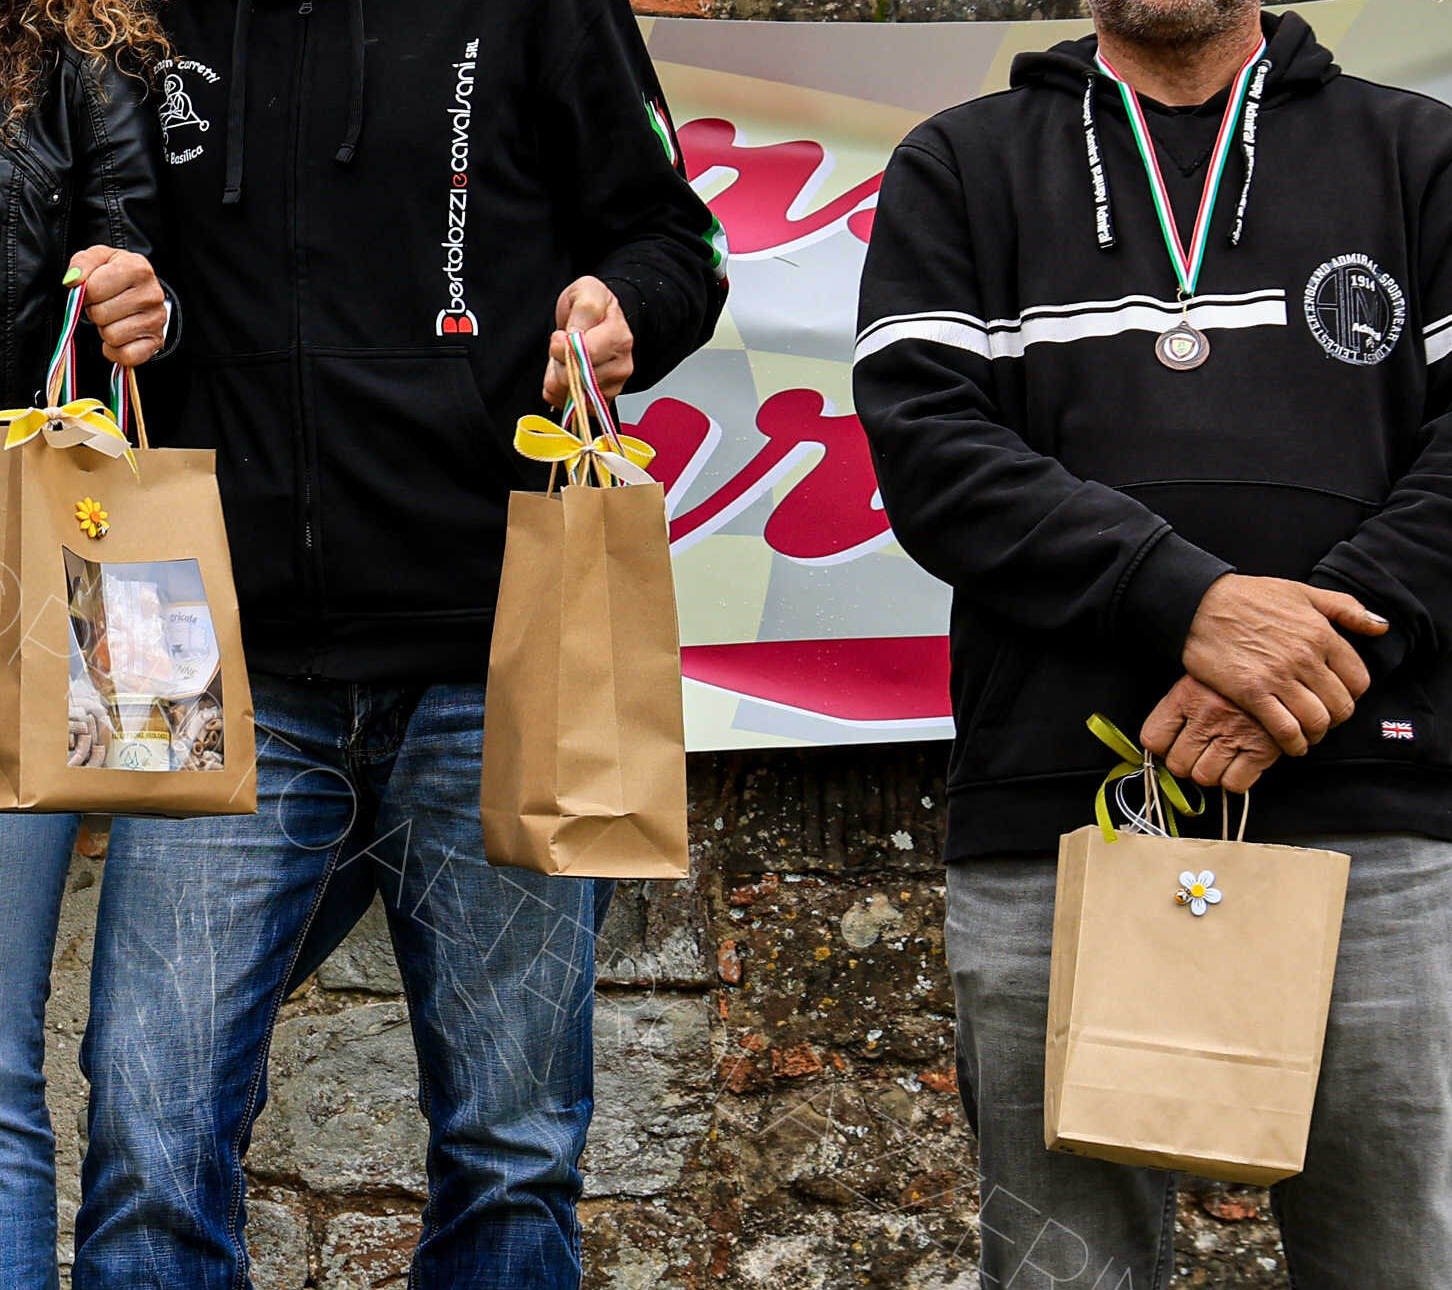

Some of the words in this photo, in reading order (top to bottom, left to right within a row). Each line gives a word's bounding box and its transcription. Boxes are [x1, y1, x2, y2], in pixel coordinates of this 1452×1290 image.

[465, 38, 479, 59] SRL
[171, 145, 203, 164] Basilica
[1331, 253, 1378, 274] ADMIRAL
[1379, 274, 1405, 341] SPORTWEAR
